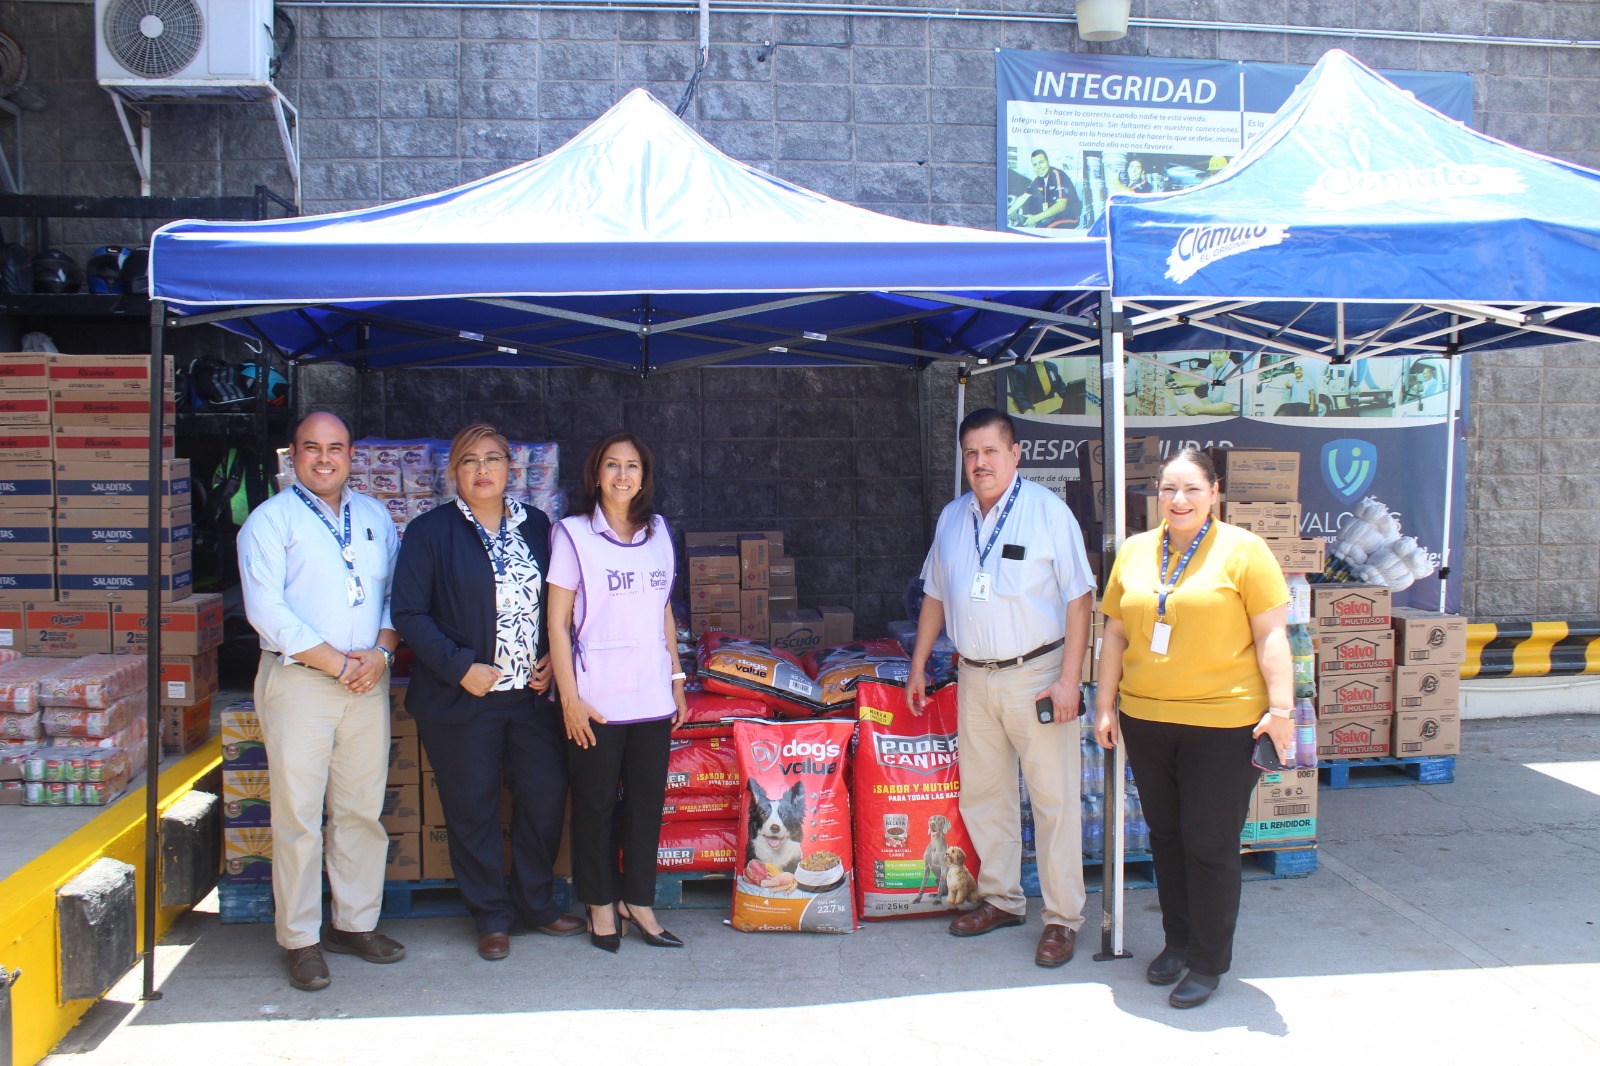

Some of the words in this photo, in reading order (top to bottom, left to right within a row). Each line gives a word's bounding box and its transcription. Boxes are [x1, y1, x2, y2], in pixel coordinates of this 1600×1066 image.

[1034, 70, 1217, 104] INTEGRIDAD
[1054, 108, 1073, 116] hacer
[1040, 118, 1068, 126] significa
[1071, 120, 1105, 128] completo.
[1120, 122, 1151, 130] faltantes
[1053, 129, 1077, 137] forjado
[1097, 130, 1135, 138] honestidad
[1200, 253, 1210, 262] EL
[91, 483, 132, 491] SALADITAS
[92, 530, 133, 539] SALADITAS
[93, 577, 133, 586] SALADITAS
[1336, 601, 1370, 616] Salvo
[40, 631, 47, 642] 2
[127, 632, 135, 643] 2
[774, 634, 820, 649] Escudo
[1340, 644, 1374, 660] Salvo
[1348, 660, 1388, 669] MULTIUSOS
[735, 664, 766, 678] value
[1339, 688, 1374, 703] Salvo
[1347, 703, 1387, 712] MULTIUSOS
[1335, 729, 1370, 745] Salvo
[881, 738, 959, 754] PODER
[1343, 745, 1383, 753] MULTIUSOS
[778, 757, 837, 776] value
[1297, 770, 1315, 778] 0067
[913, 784, 919, 792] Y
[1270, 820, 1311, 829] RENDIDOR
[817, 905, 836, 913] 22.7
